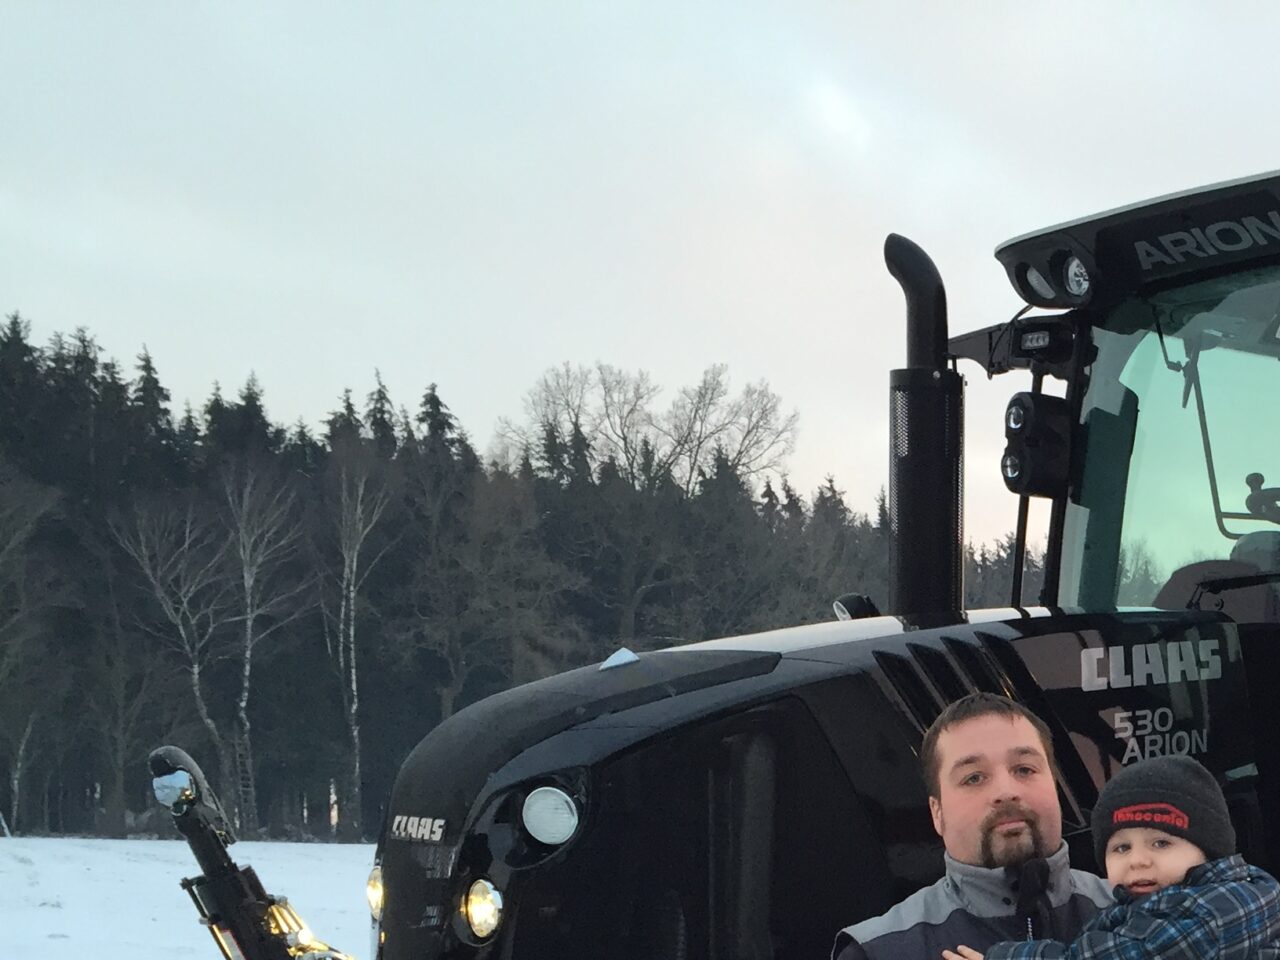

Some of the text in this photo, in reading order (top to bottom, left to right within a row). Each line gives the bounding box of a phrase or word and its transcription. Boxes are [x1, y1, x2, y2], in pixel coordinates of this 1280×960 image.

[1081, 639, 1222, 692] CLAAS
[1114, 706, 1174, 739] 530
[1121, 728, 1208, 765] ARION
[392, 815, 446, 841] CLAAS
